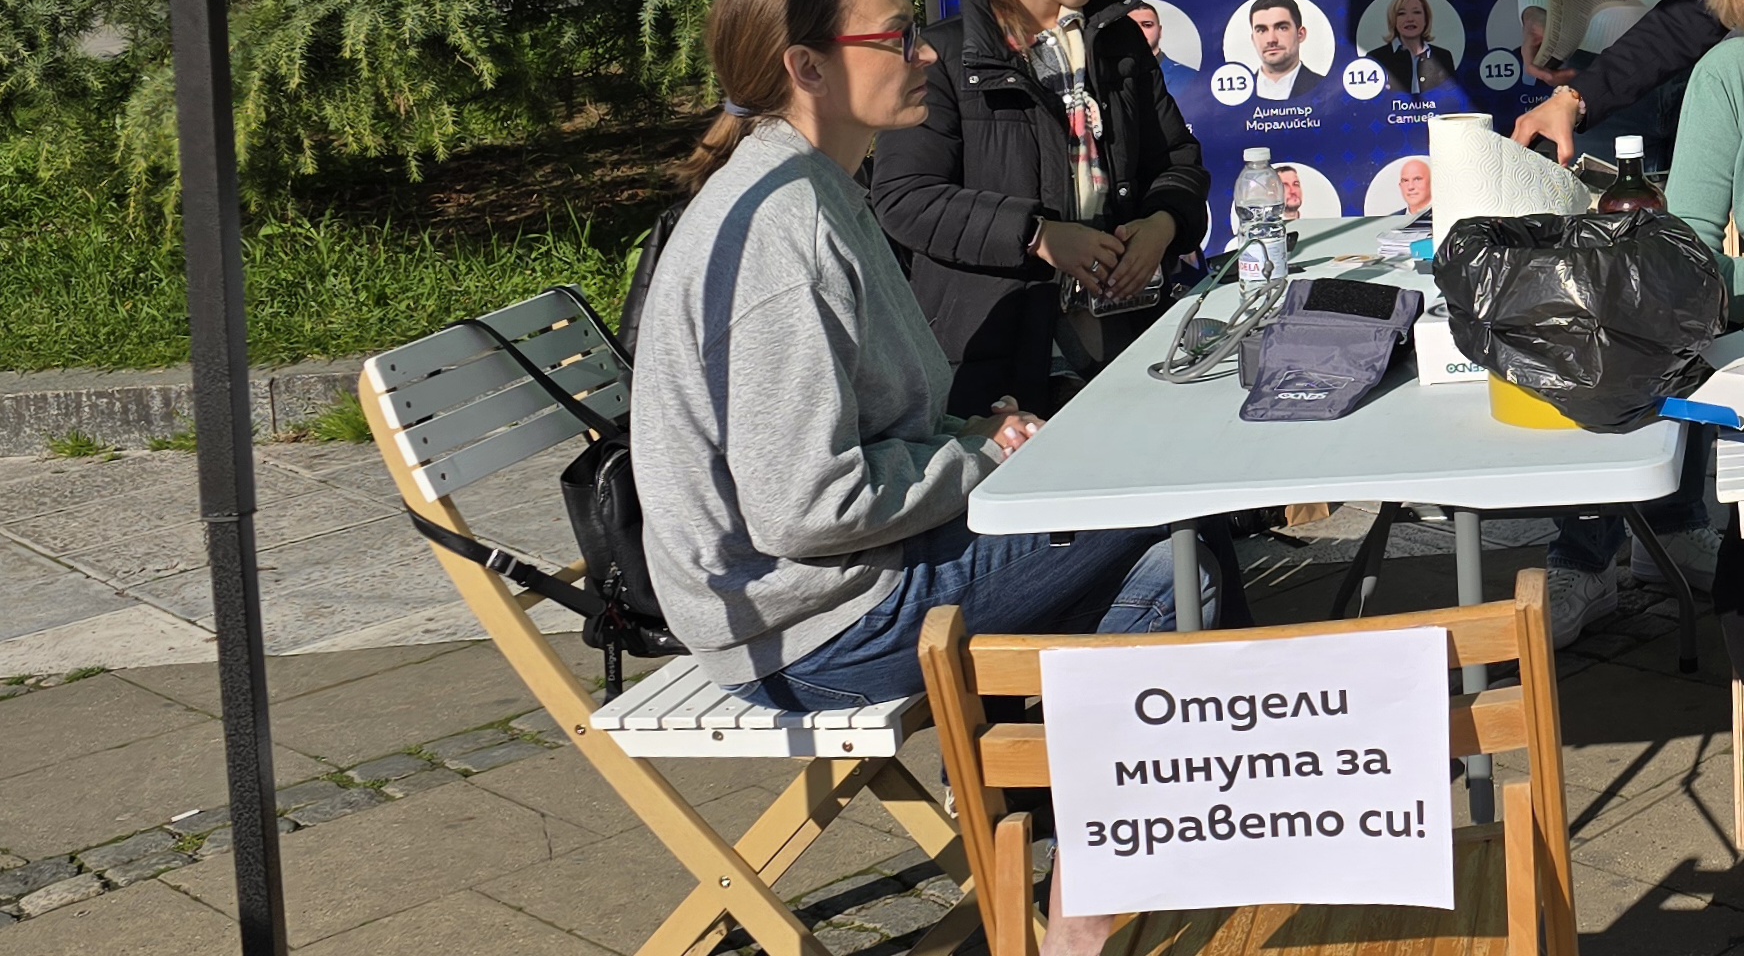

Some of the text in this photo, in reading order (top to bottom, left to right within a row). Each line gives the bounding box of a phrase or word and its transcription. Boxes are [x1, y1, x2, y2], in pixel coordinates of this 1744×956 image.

[1348, 69, 1379, 85] 114
[1486, 64, 1515, 79] 115
[1216, 76, 1248, 92] 113
[1252, 106, 1313, 120] Димитър
[1392, 99, 1437, 111] Полина
[1245, 117, 1321, 133] Моралийски
[1387, 111, 1441, 124] Сатиев
[1134, 687, 1350, 732] Отдели
[1115, 747, 1391, 794] минута за
[1086, 800, 1426, 857] здравето си!
